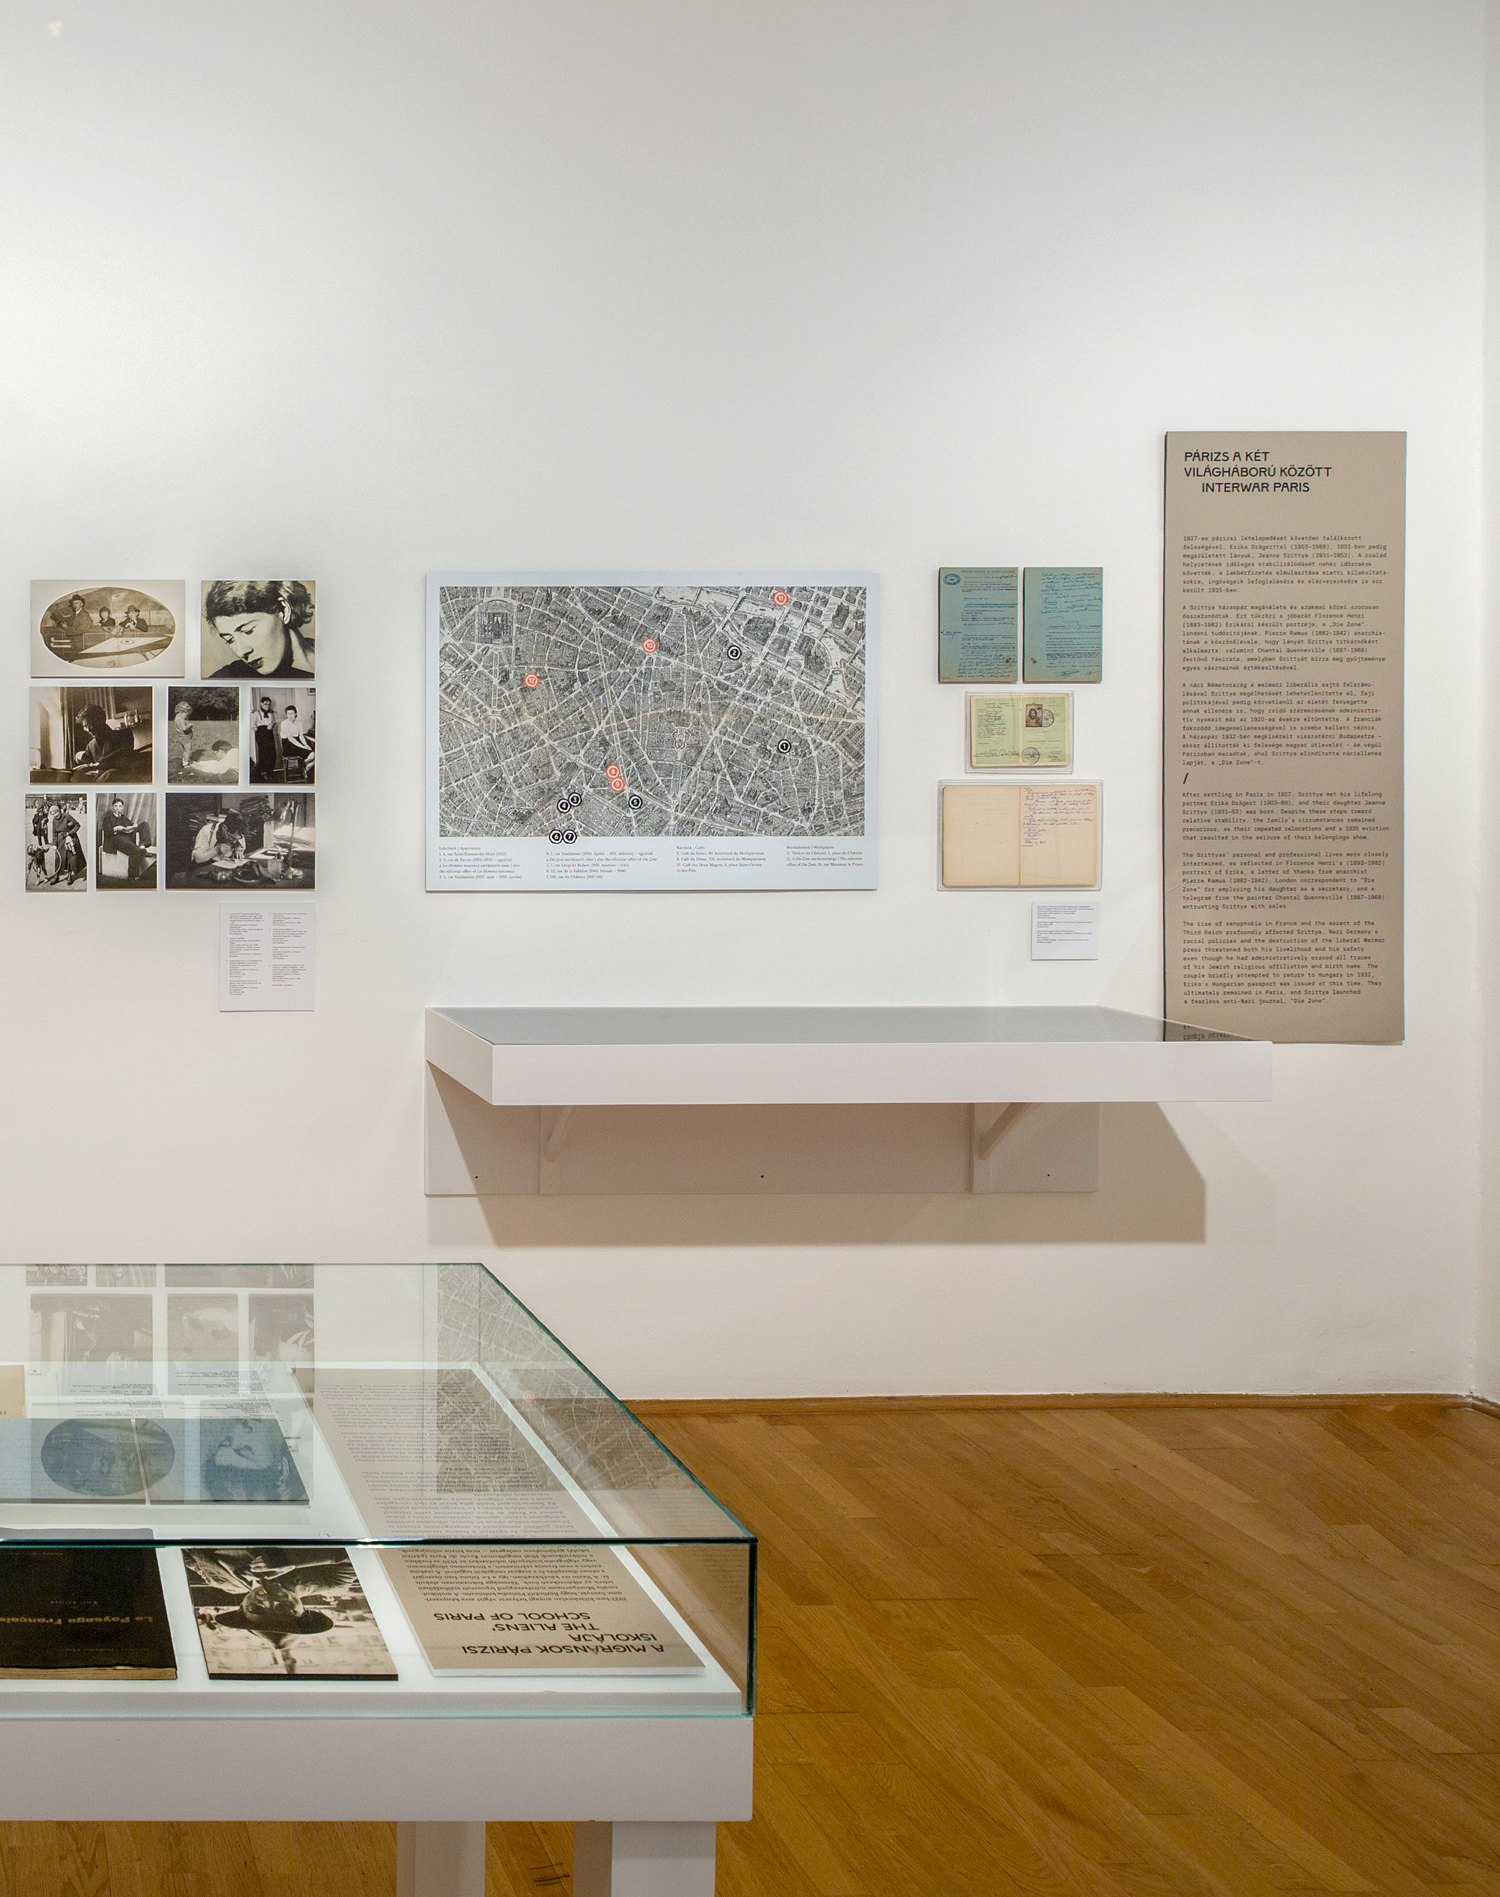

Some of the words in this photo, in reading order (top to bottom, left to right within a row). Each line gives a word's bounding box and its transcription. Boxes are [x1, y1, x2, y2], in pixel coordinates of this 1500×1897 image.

[1184, 448, 1230, 463] PÁRIZS
[1232, 451, 1242, 462] A
[1245, 448, 1271, 462] KÉT
[1183, 465, 1277, 478] VILÁGHÁBORÚ
[1279, 465, 1333, 478] KÖZÖTT
[1201, 482, 1270, 493] INTERWAR
[1273, 481, 1311, 493] PARIS
[433, 1612, 485, 1621] PARIS
[516, 1612, 591, 1620] SCHOOL
[561, 1622, 600, 1631] THE
[568, 1633, 657, 1643] ISKOLÁJA
[462, 1645, 533, 1656] PÁRIZSI
[538, 1644, 647, 1655] MIGRÁNSOK
[650, 1644, 665, 1653] A
